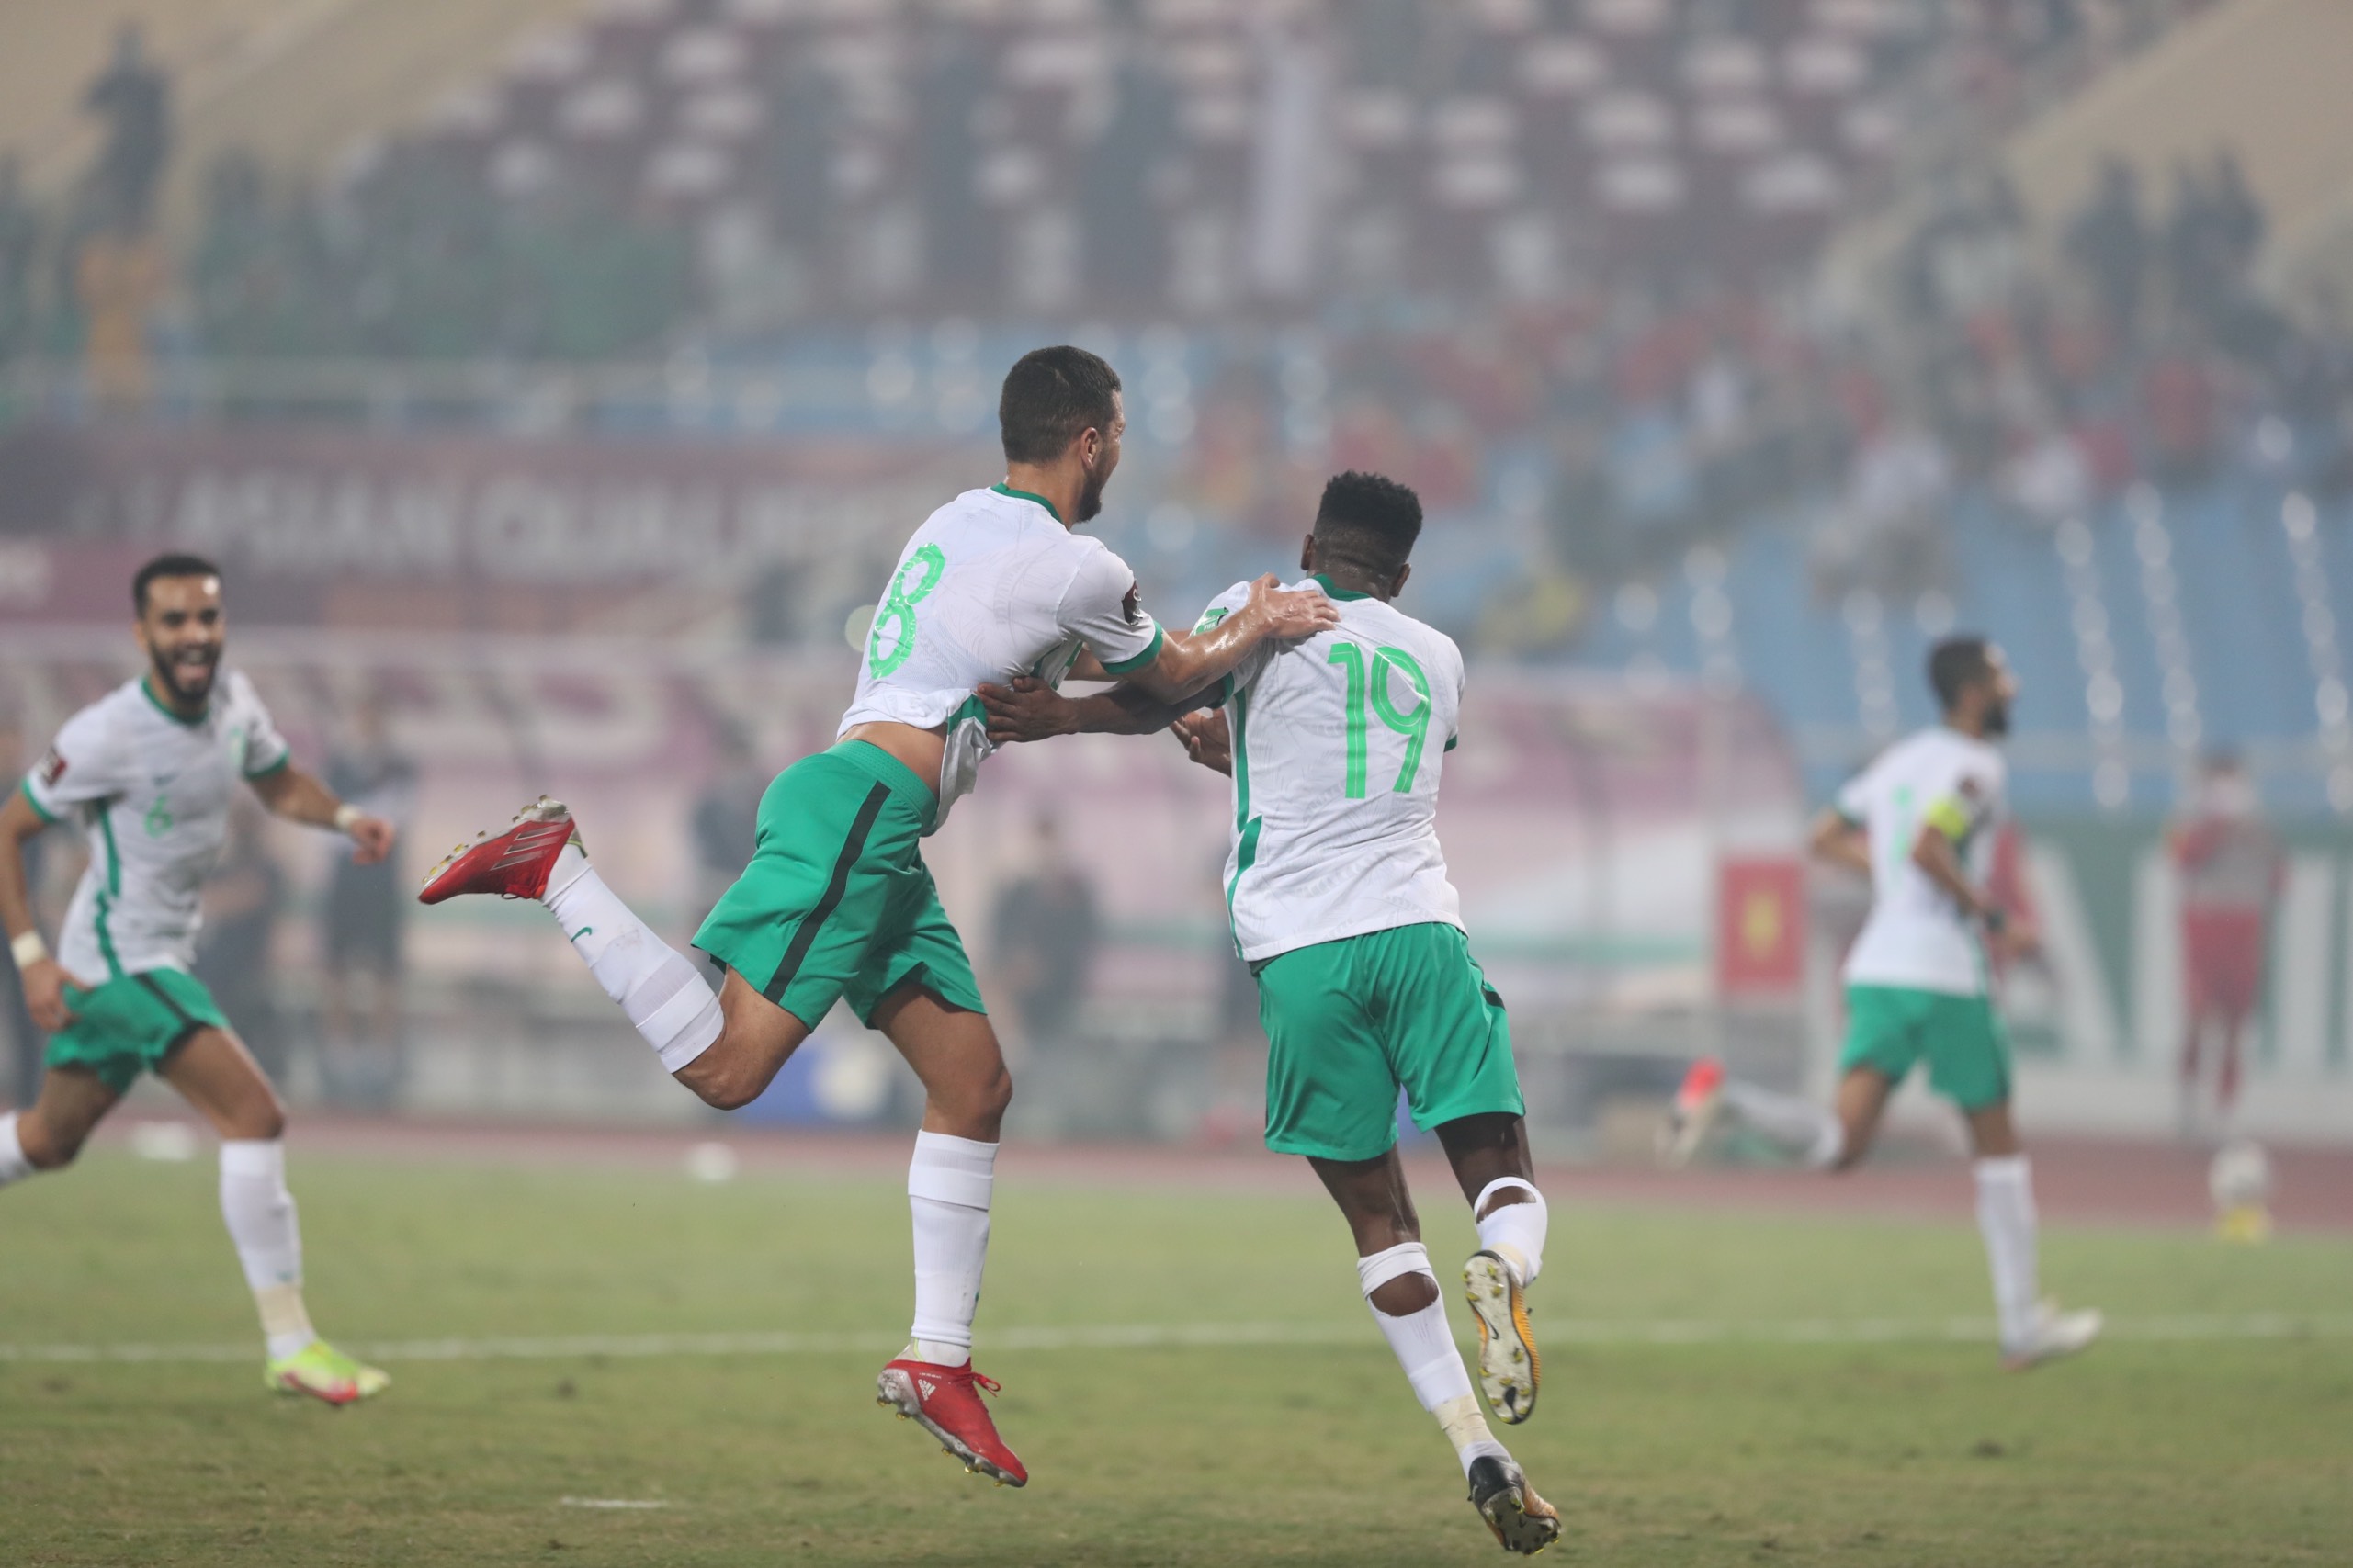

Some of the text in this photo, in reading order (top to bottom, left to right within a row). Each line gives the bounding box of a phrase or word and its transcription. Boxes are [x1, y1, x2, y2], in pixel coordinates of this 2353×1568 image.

[869, 542, 945, 679] 8
[1327, 642, 1431, 798] 19
[143, 795, 174, 838] 6
